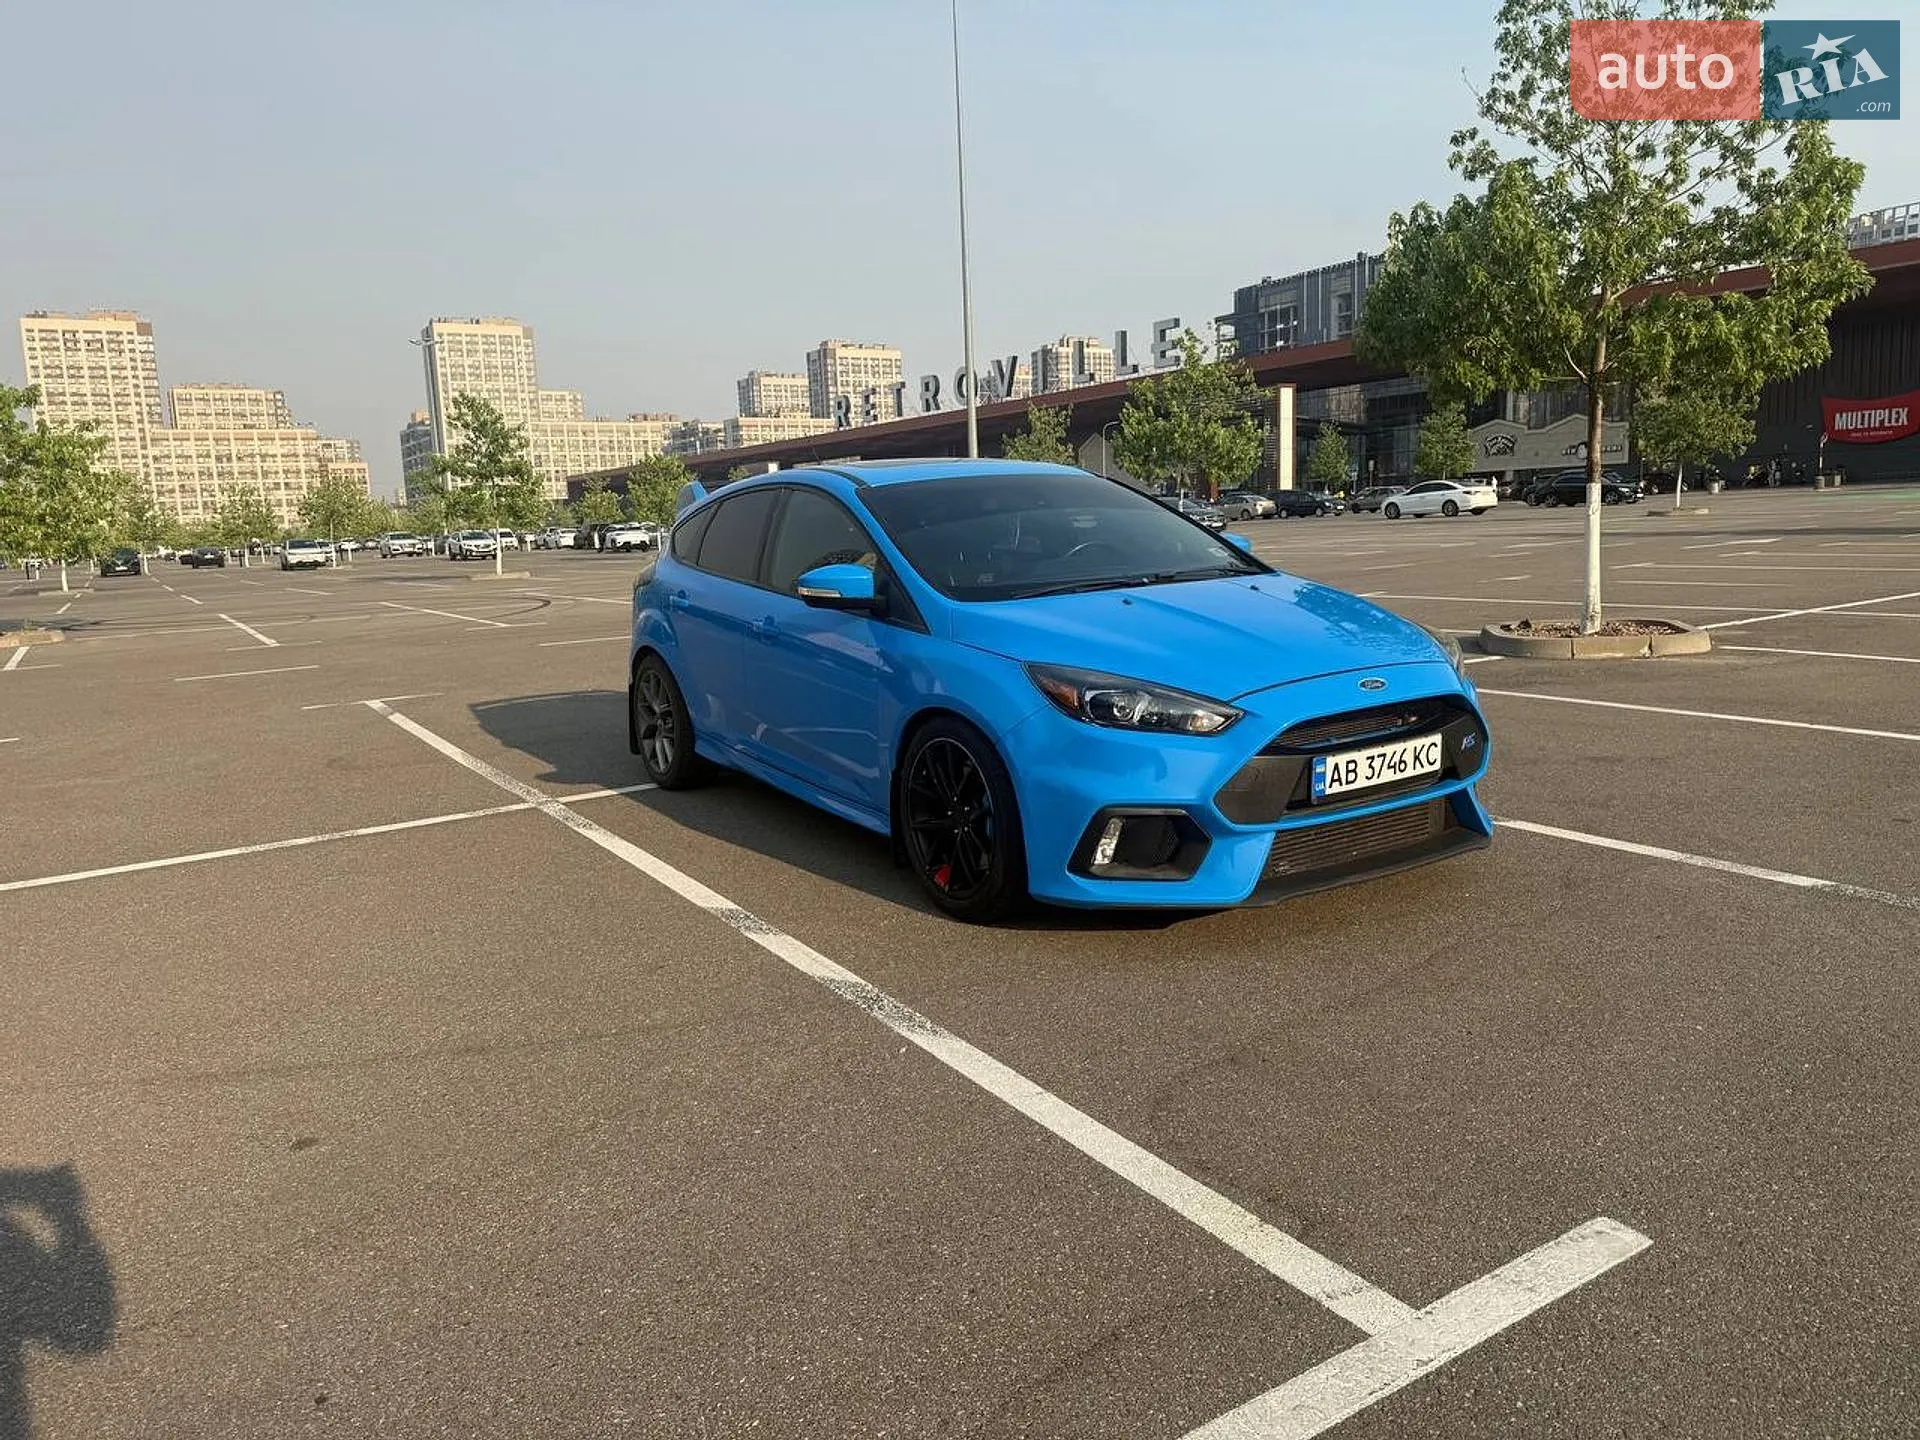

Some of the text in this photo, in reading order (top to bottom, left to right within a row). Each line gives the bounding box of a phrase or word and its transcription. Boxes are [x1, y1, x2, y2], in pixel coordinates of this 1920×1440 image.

[834, 317, 1181, 429] RETROVILLE
[1834, 408, 1909, 431] MULTIPLEX
[1328, 742, 1439, 789] AB 3746 KC
